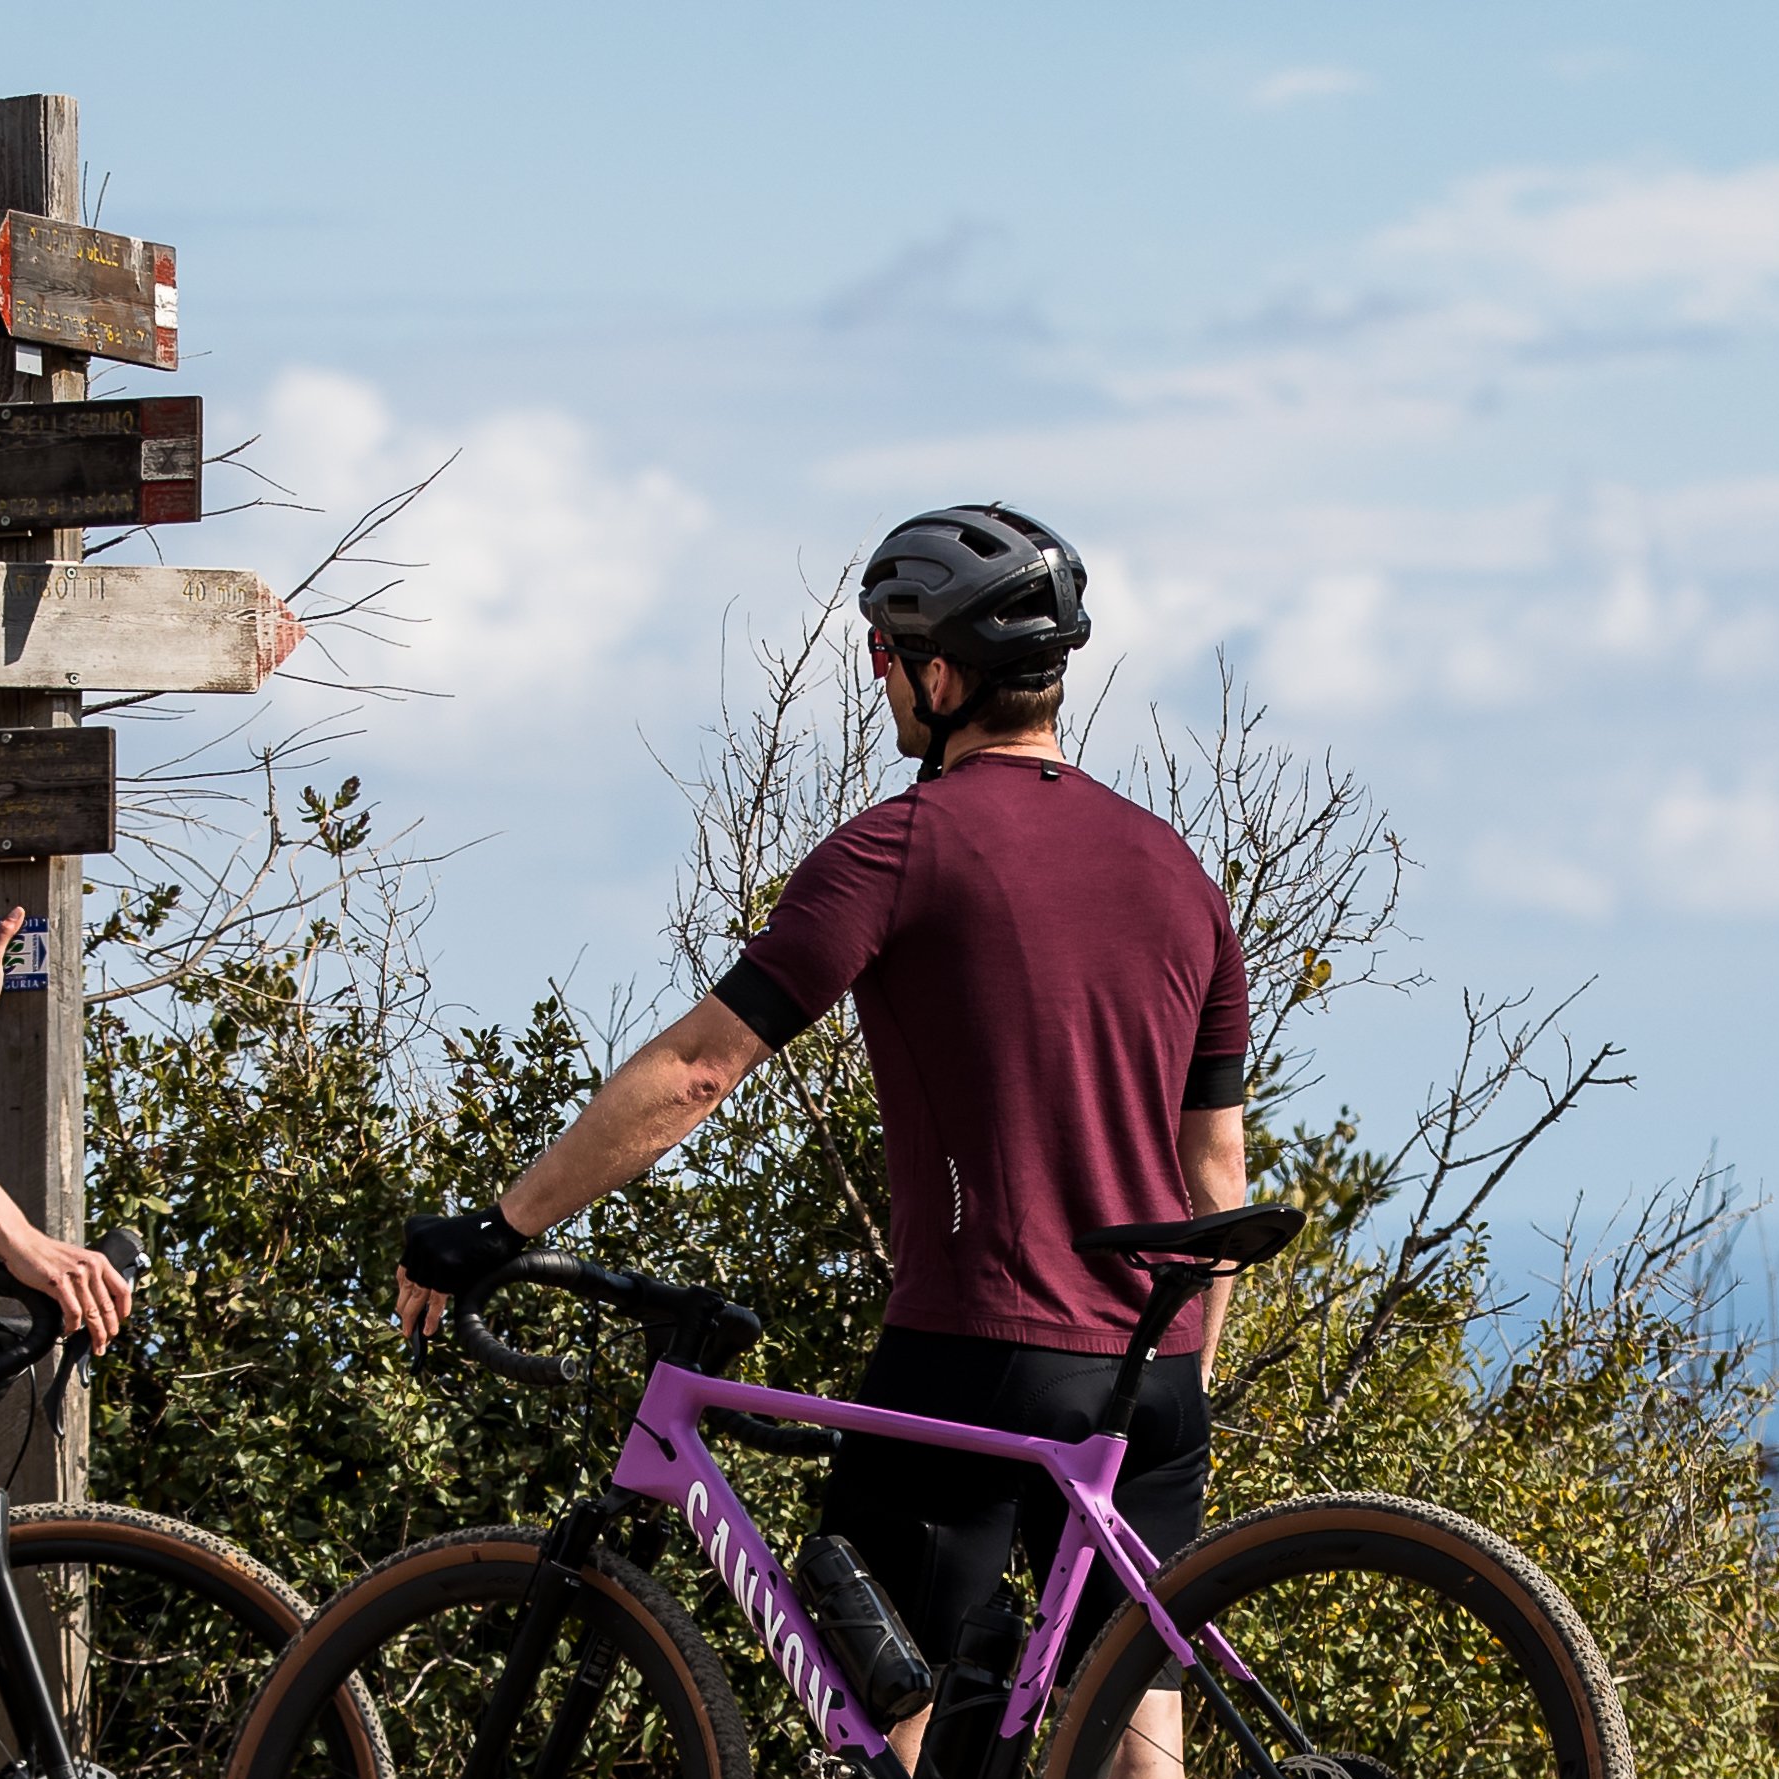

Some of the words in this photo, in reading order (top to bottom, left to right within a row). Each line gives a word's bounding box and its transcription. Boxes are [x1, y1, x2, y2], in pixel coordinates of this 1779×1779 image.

[182, 580, 206, 602] 40
[217, 582, 248, 604] min
[5, 979, 39, 989] GURIA
[687, 1480, 833, 1745] CANYON
